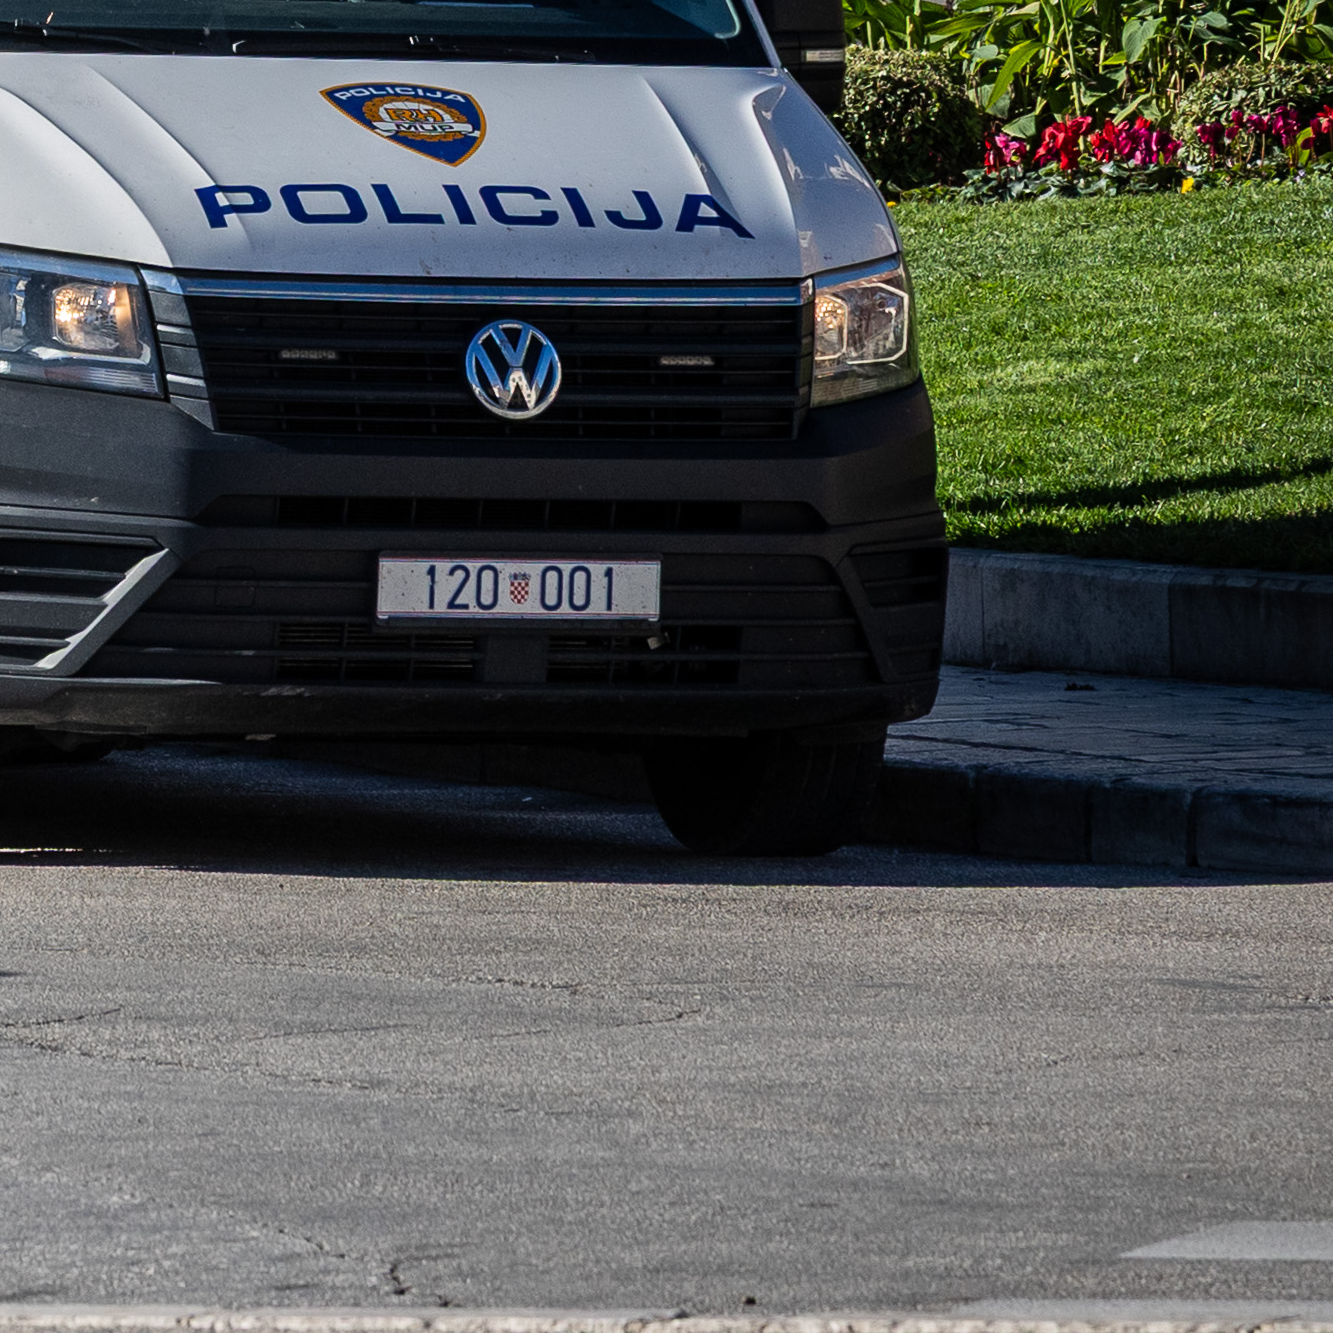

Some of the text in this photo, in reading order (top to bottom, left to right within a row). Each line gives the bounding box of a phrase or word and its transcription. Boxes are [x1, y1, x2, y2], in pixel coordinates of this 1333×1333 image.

[334, 86, 466, 103] POLICIJA
[194, 183, 756, 240] POLICIJA
[426, 564, 614, 612] 120 001
